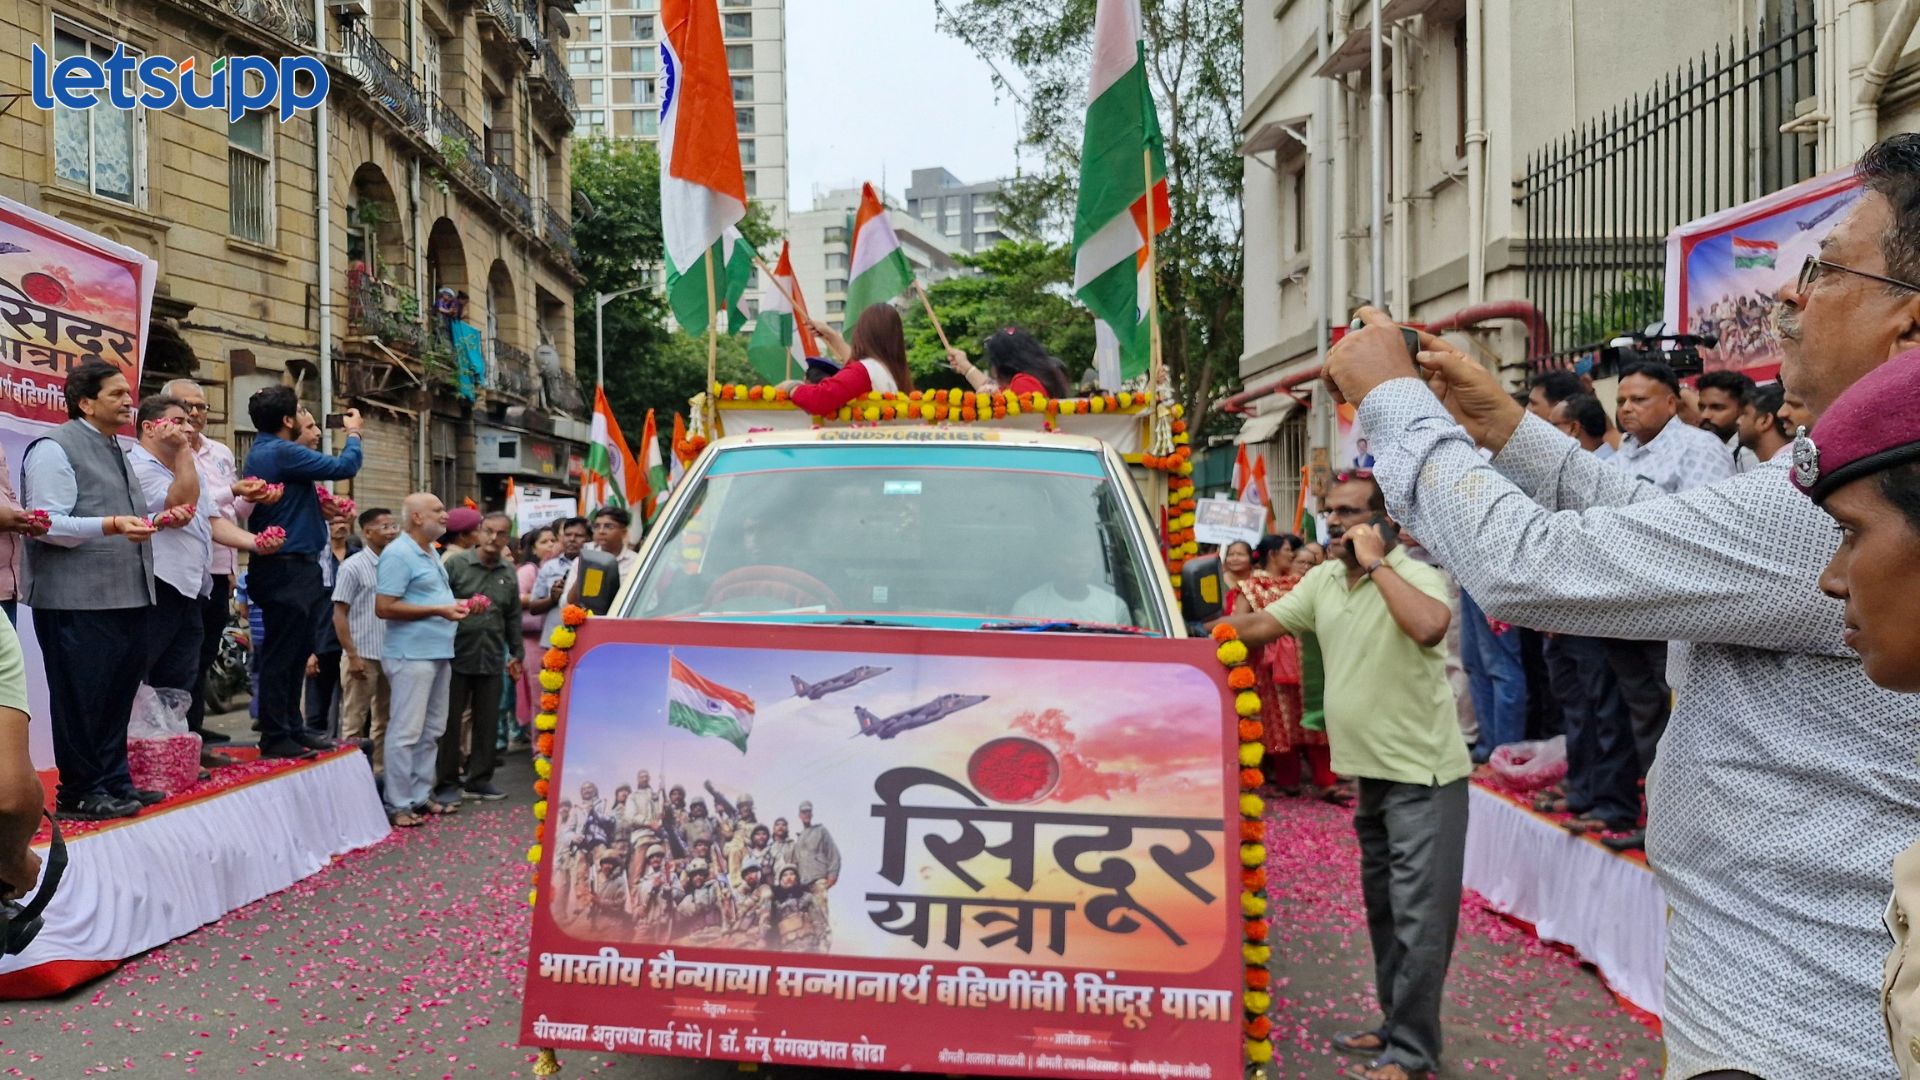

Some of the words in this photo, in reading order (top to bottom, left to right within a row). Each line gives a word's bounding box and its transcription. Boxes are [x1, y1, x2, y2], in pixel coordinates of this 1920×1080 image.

[865, 892, 1076, 956] यात्रा
[539, 946, 643, 987] भारतीय
[648, 949, 771, 996] सैन्याच्या
[776, 965, 933, 1005] सन्मानार्थ
[936, 965, 1066, 1012] बहिणींची
[1074, 970, 1153, 1030] सिंदूर
[1160, 986, 1232, 1022] यात्रा
[592, 1023, 646, 1051] अनुराधा
[648, 1021, 675, 1051] ताई
[744, 1028, 772, 1063] मंजू
[851, 1034, 887, 1063] लोढा
